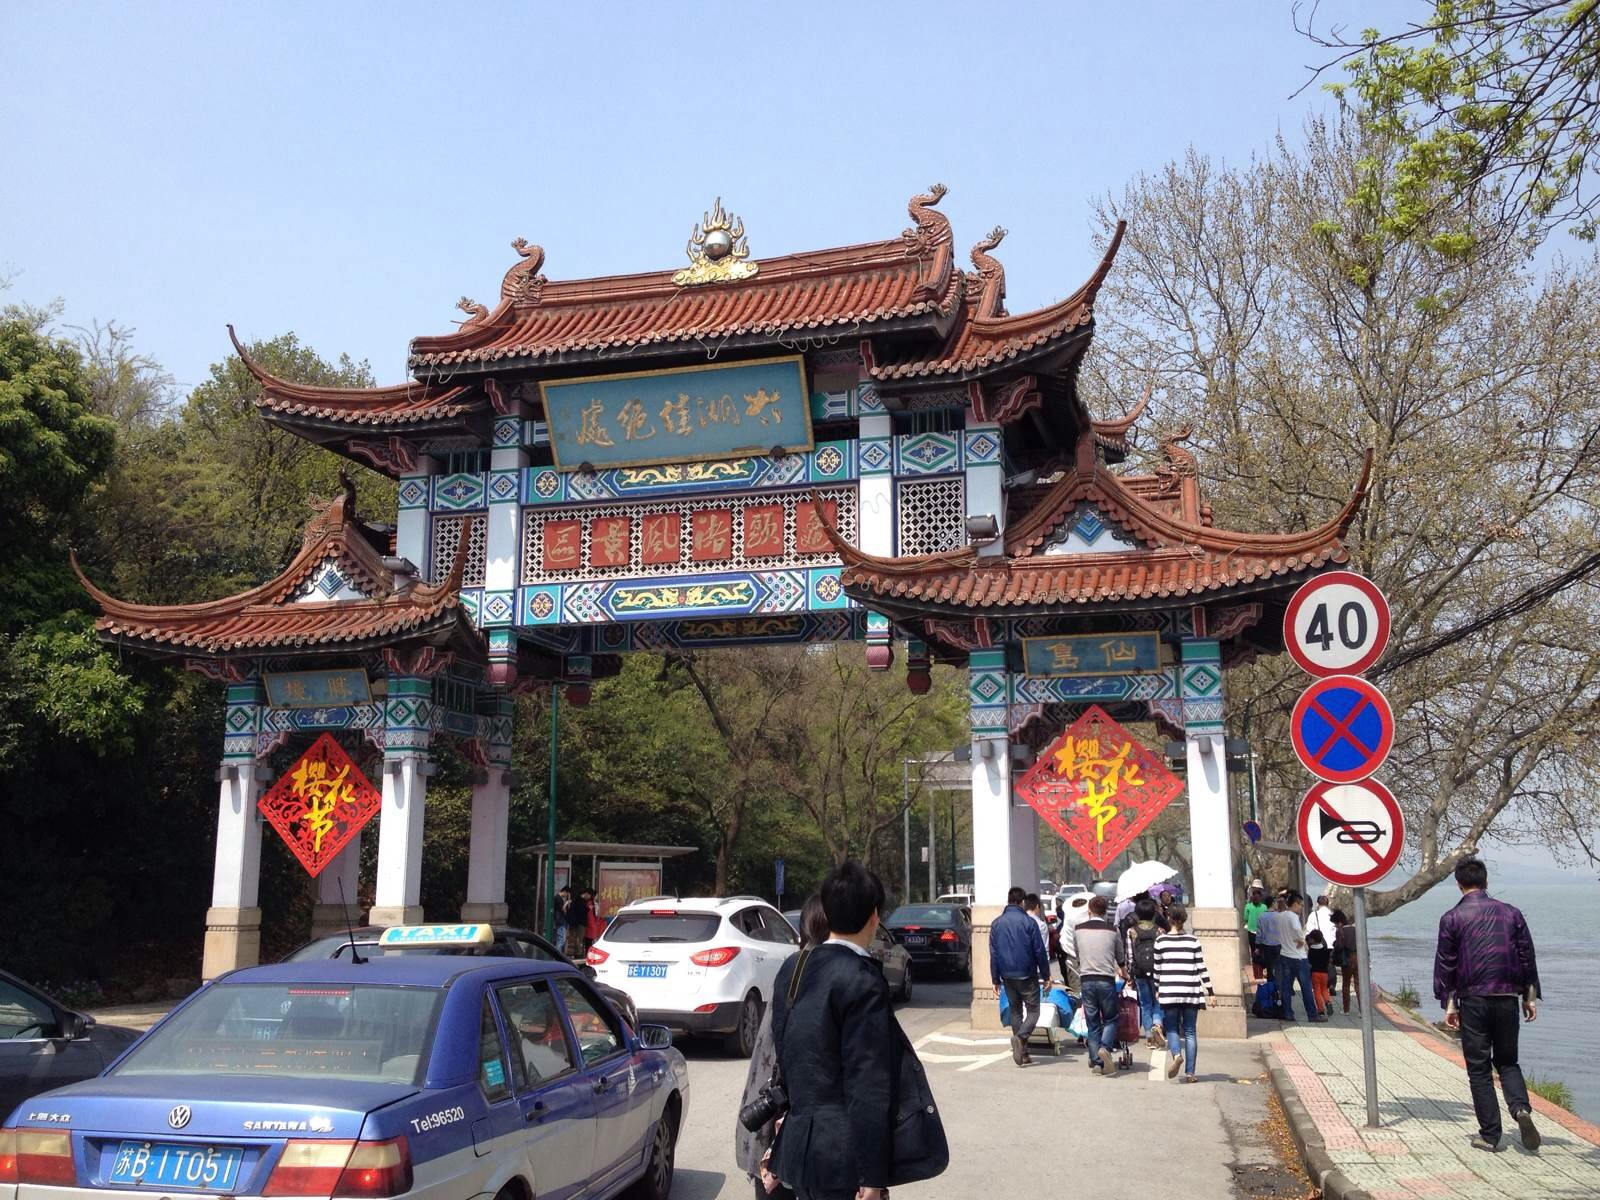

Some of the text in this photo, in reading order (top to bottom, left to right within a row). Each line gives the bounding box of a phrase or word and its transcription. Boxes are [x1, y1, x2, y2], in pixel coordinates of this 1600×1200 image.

[1305, 600, 1368, 651] 40
[397, 926, 474, 938] TAXI
[243, 1120, 307, 1131] SANTANA
